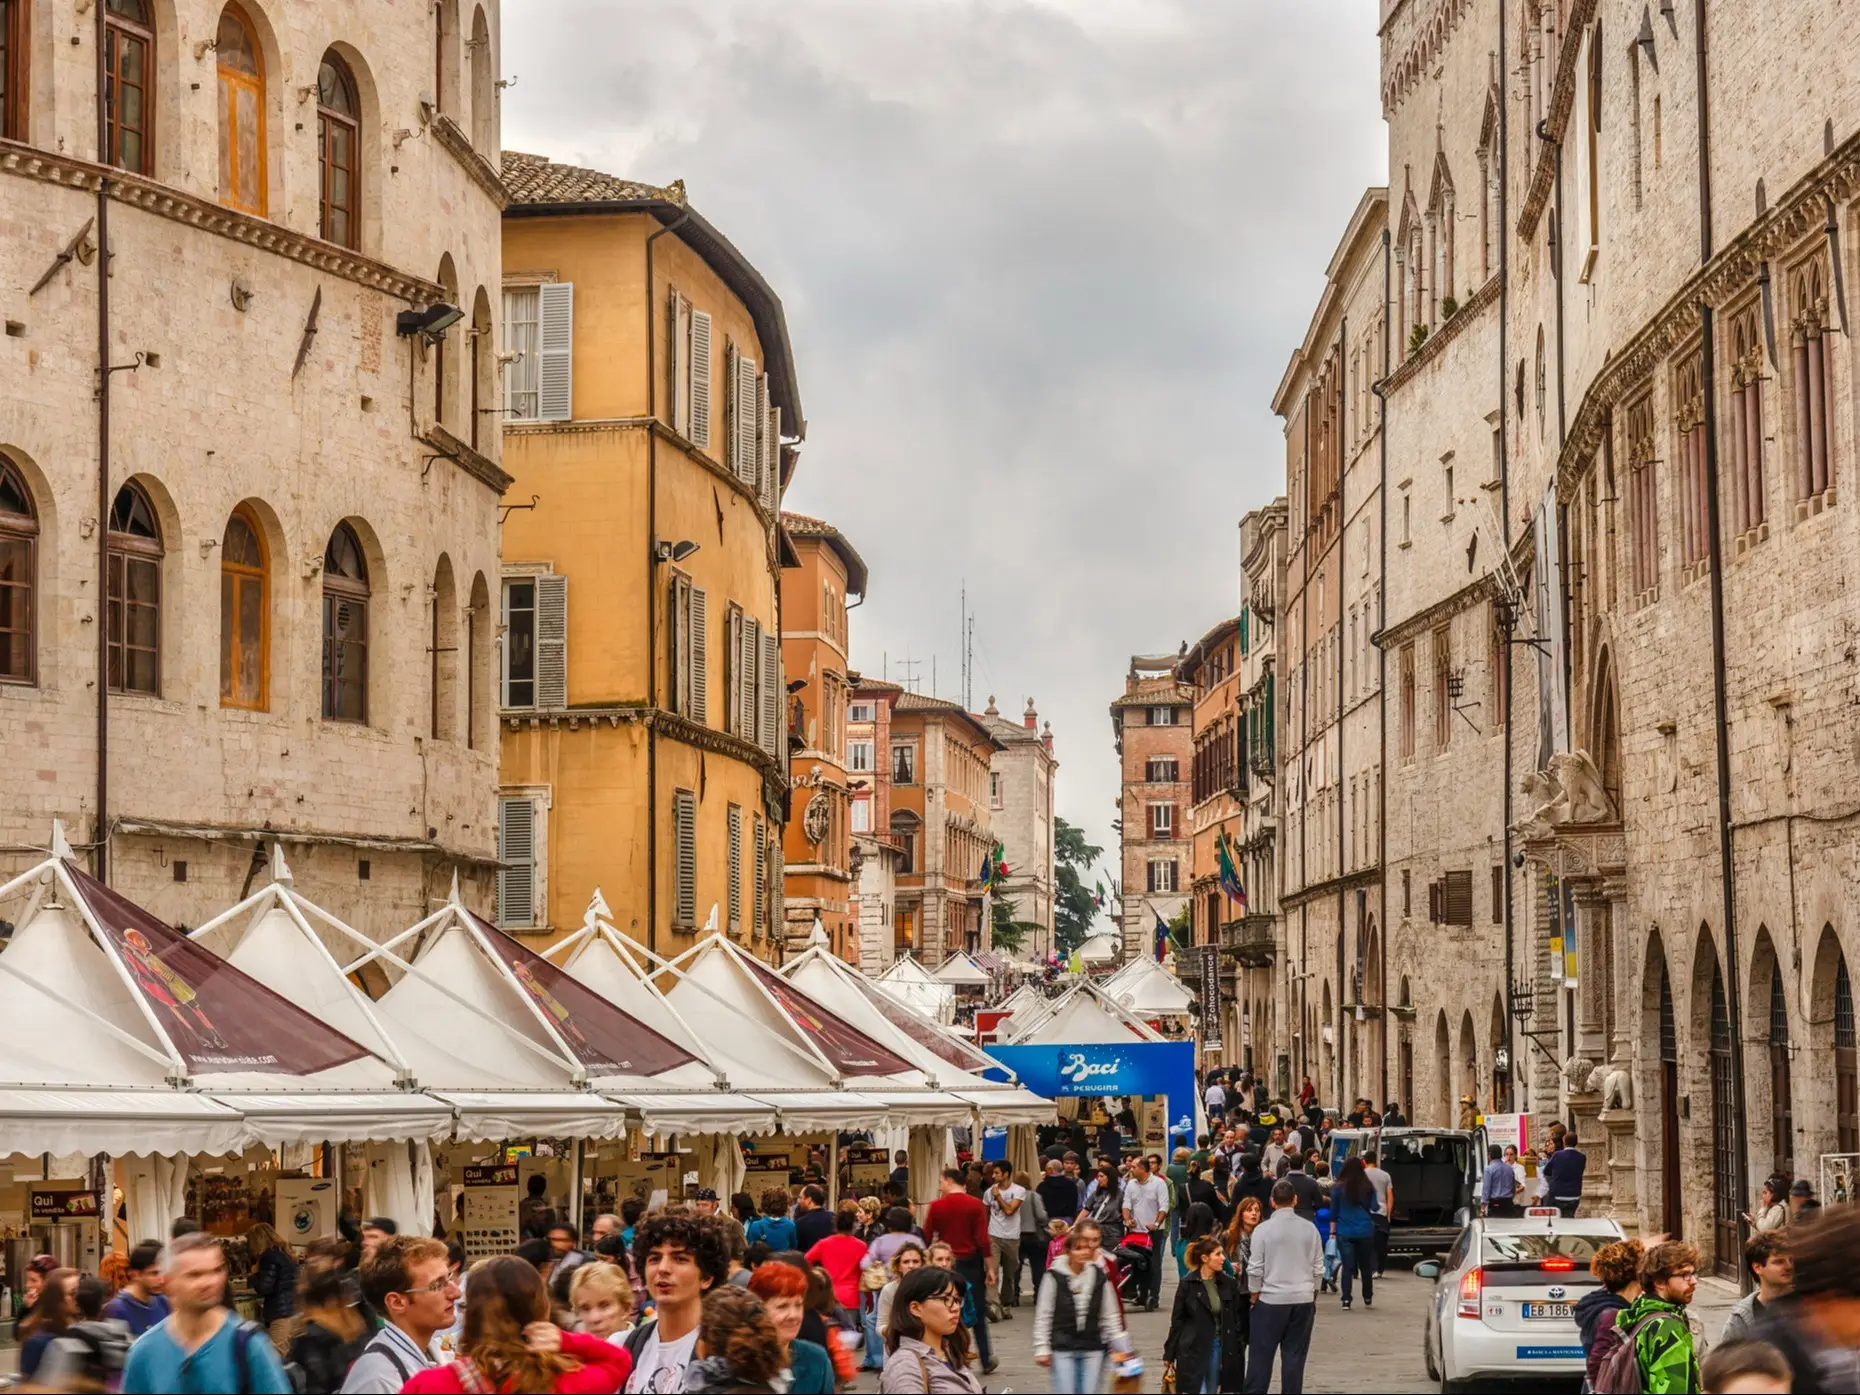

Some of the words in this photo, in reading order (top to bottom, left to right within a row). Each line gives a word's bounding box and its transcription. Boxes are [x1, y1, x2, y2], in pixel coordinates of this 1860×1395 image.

[1207, 954, 1216, 1014] chocodance
[1060, 1053, 1121, 1082] Baci
[465, 1169, 482, 1178] Qui
[34, 1195, 53, 1206] Qui
